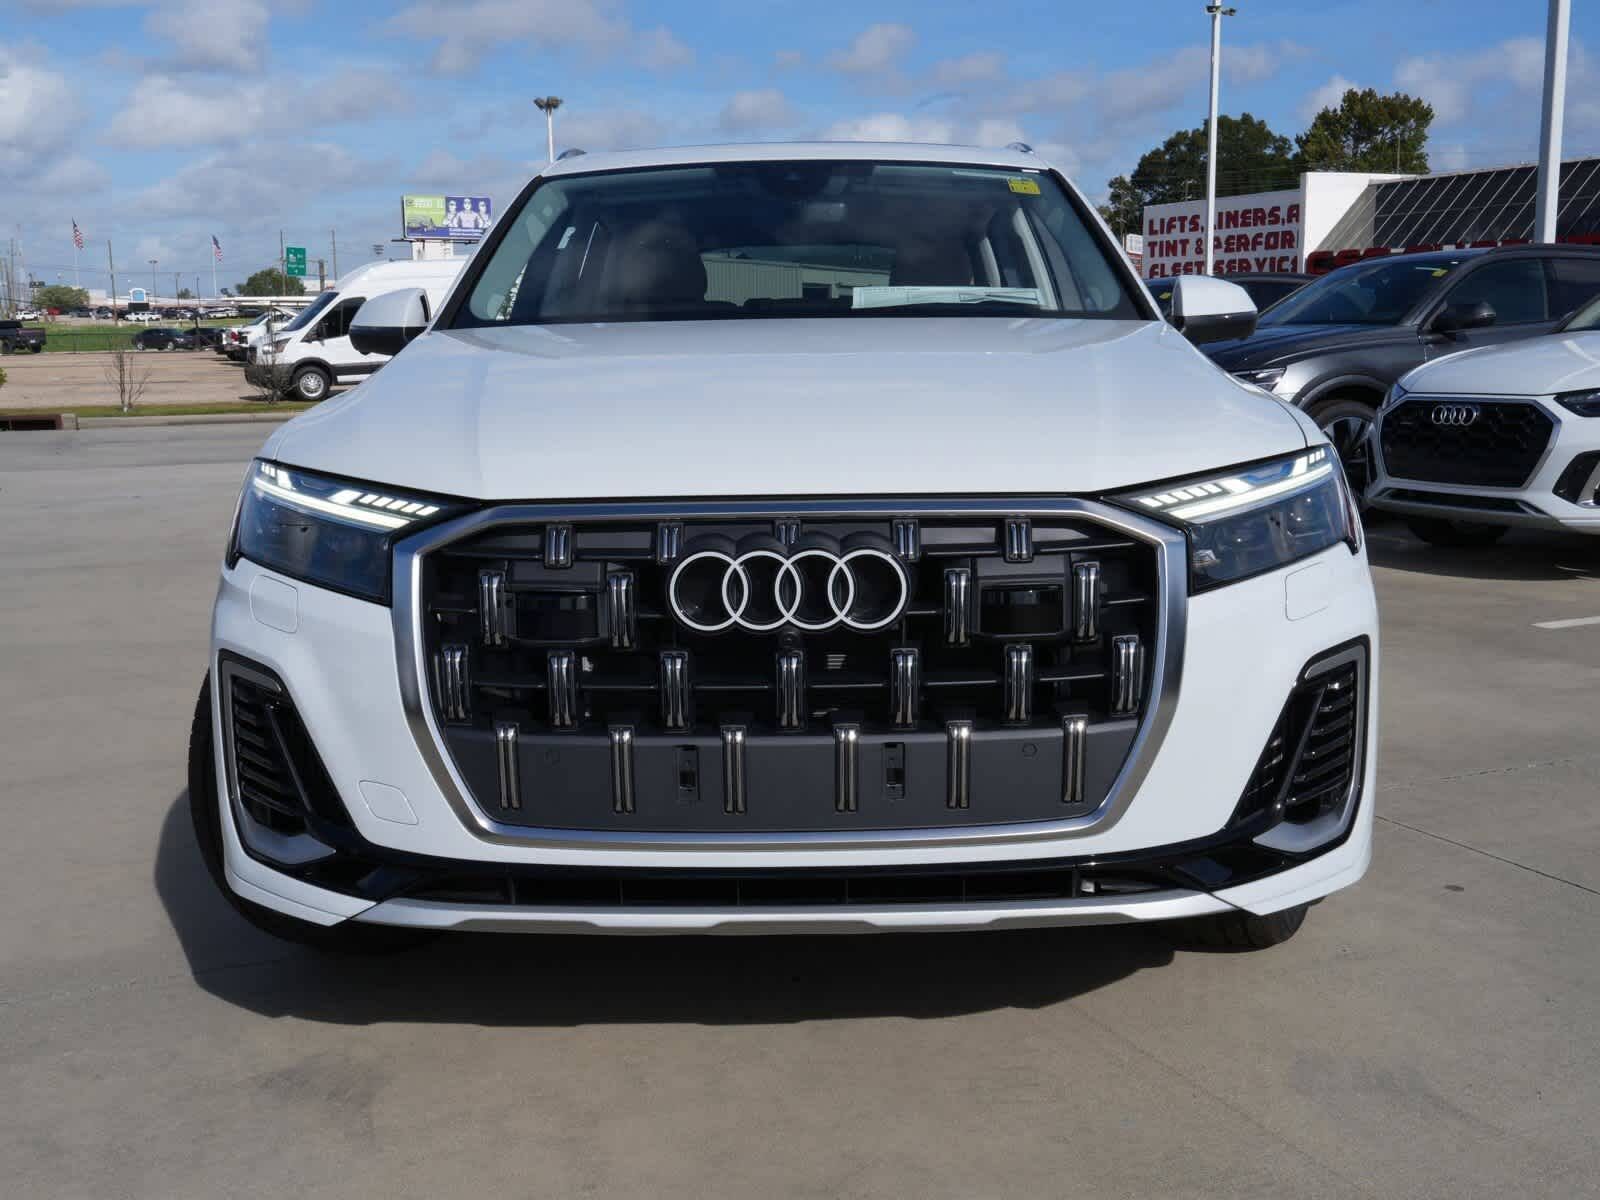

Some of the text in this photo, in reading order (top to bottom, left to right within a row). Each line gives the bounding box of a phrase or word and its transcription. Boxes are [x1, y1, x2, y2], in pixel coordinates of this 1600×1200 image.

[1147, 230, 1299, 258] TINT & PERFOR
[1149, 260, 1205, 279] FLEET
